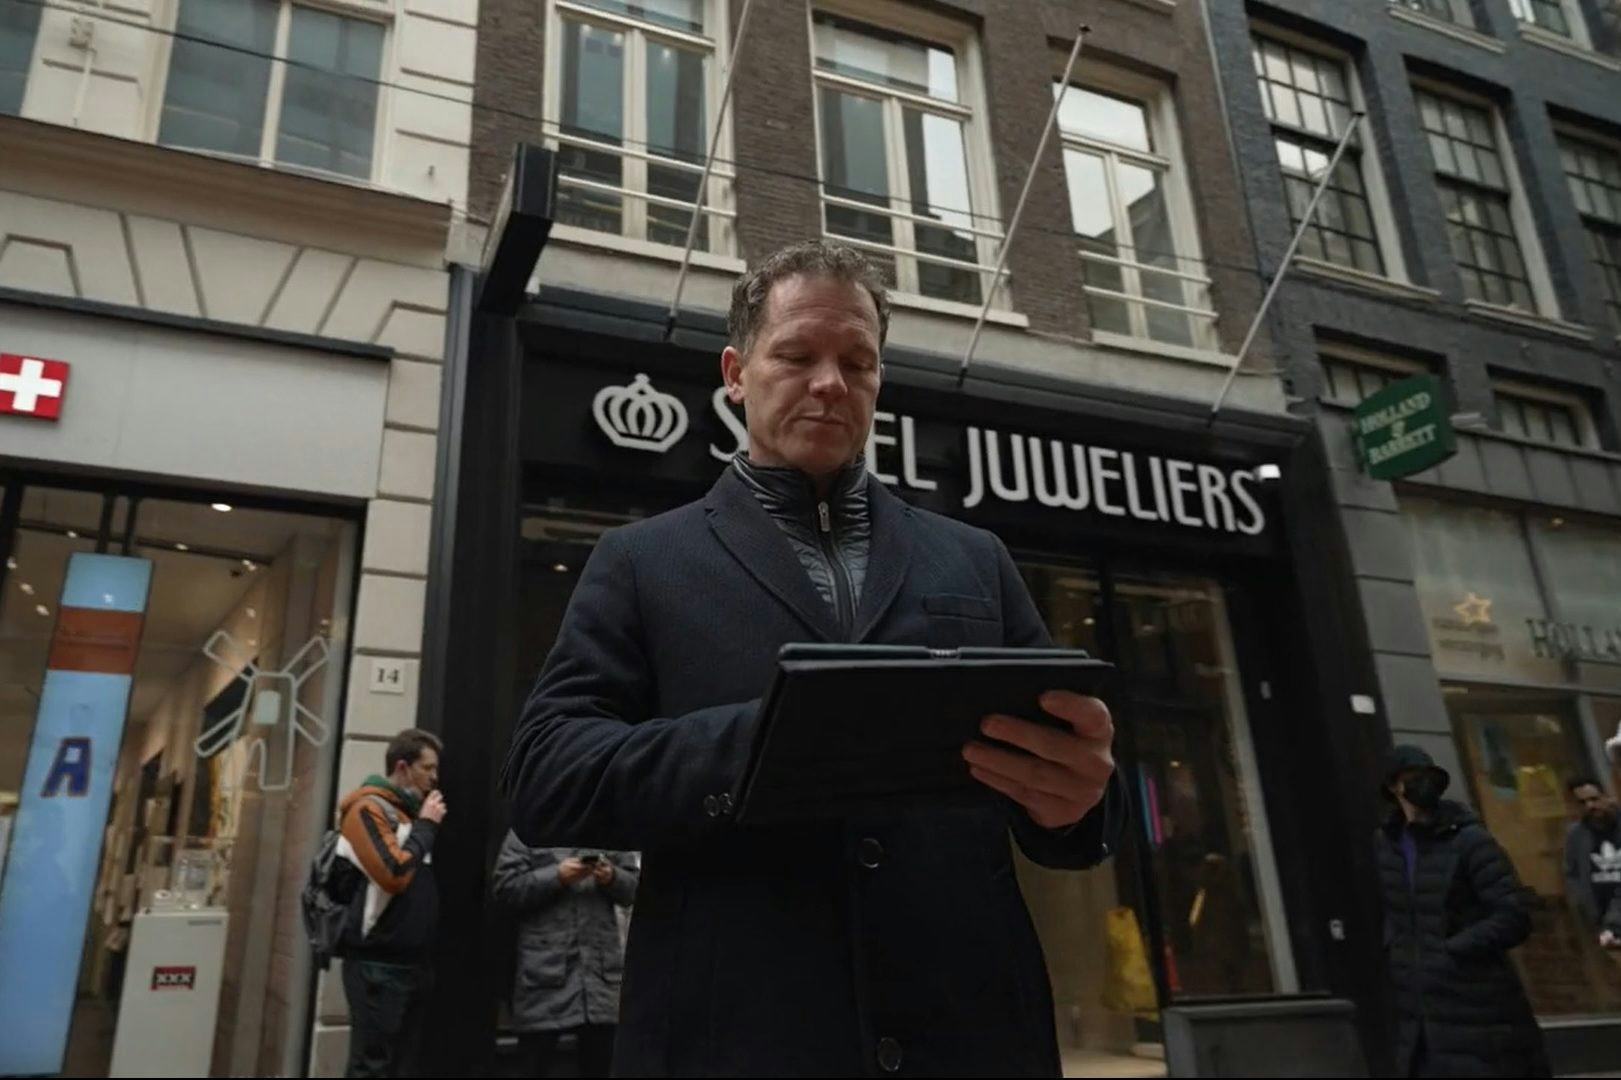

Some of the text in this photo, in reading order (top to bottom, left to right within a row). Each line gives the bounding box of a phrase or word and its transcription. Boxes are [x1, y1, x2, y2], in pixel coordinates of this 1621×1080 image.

[1361, 391, 1431, 434] HOLLAND
[709, 386, 1265, 534] SEL JUWELIERS
[376, 667, 400, 684] 14
[40, 736, 92, 797] A
